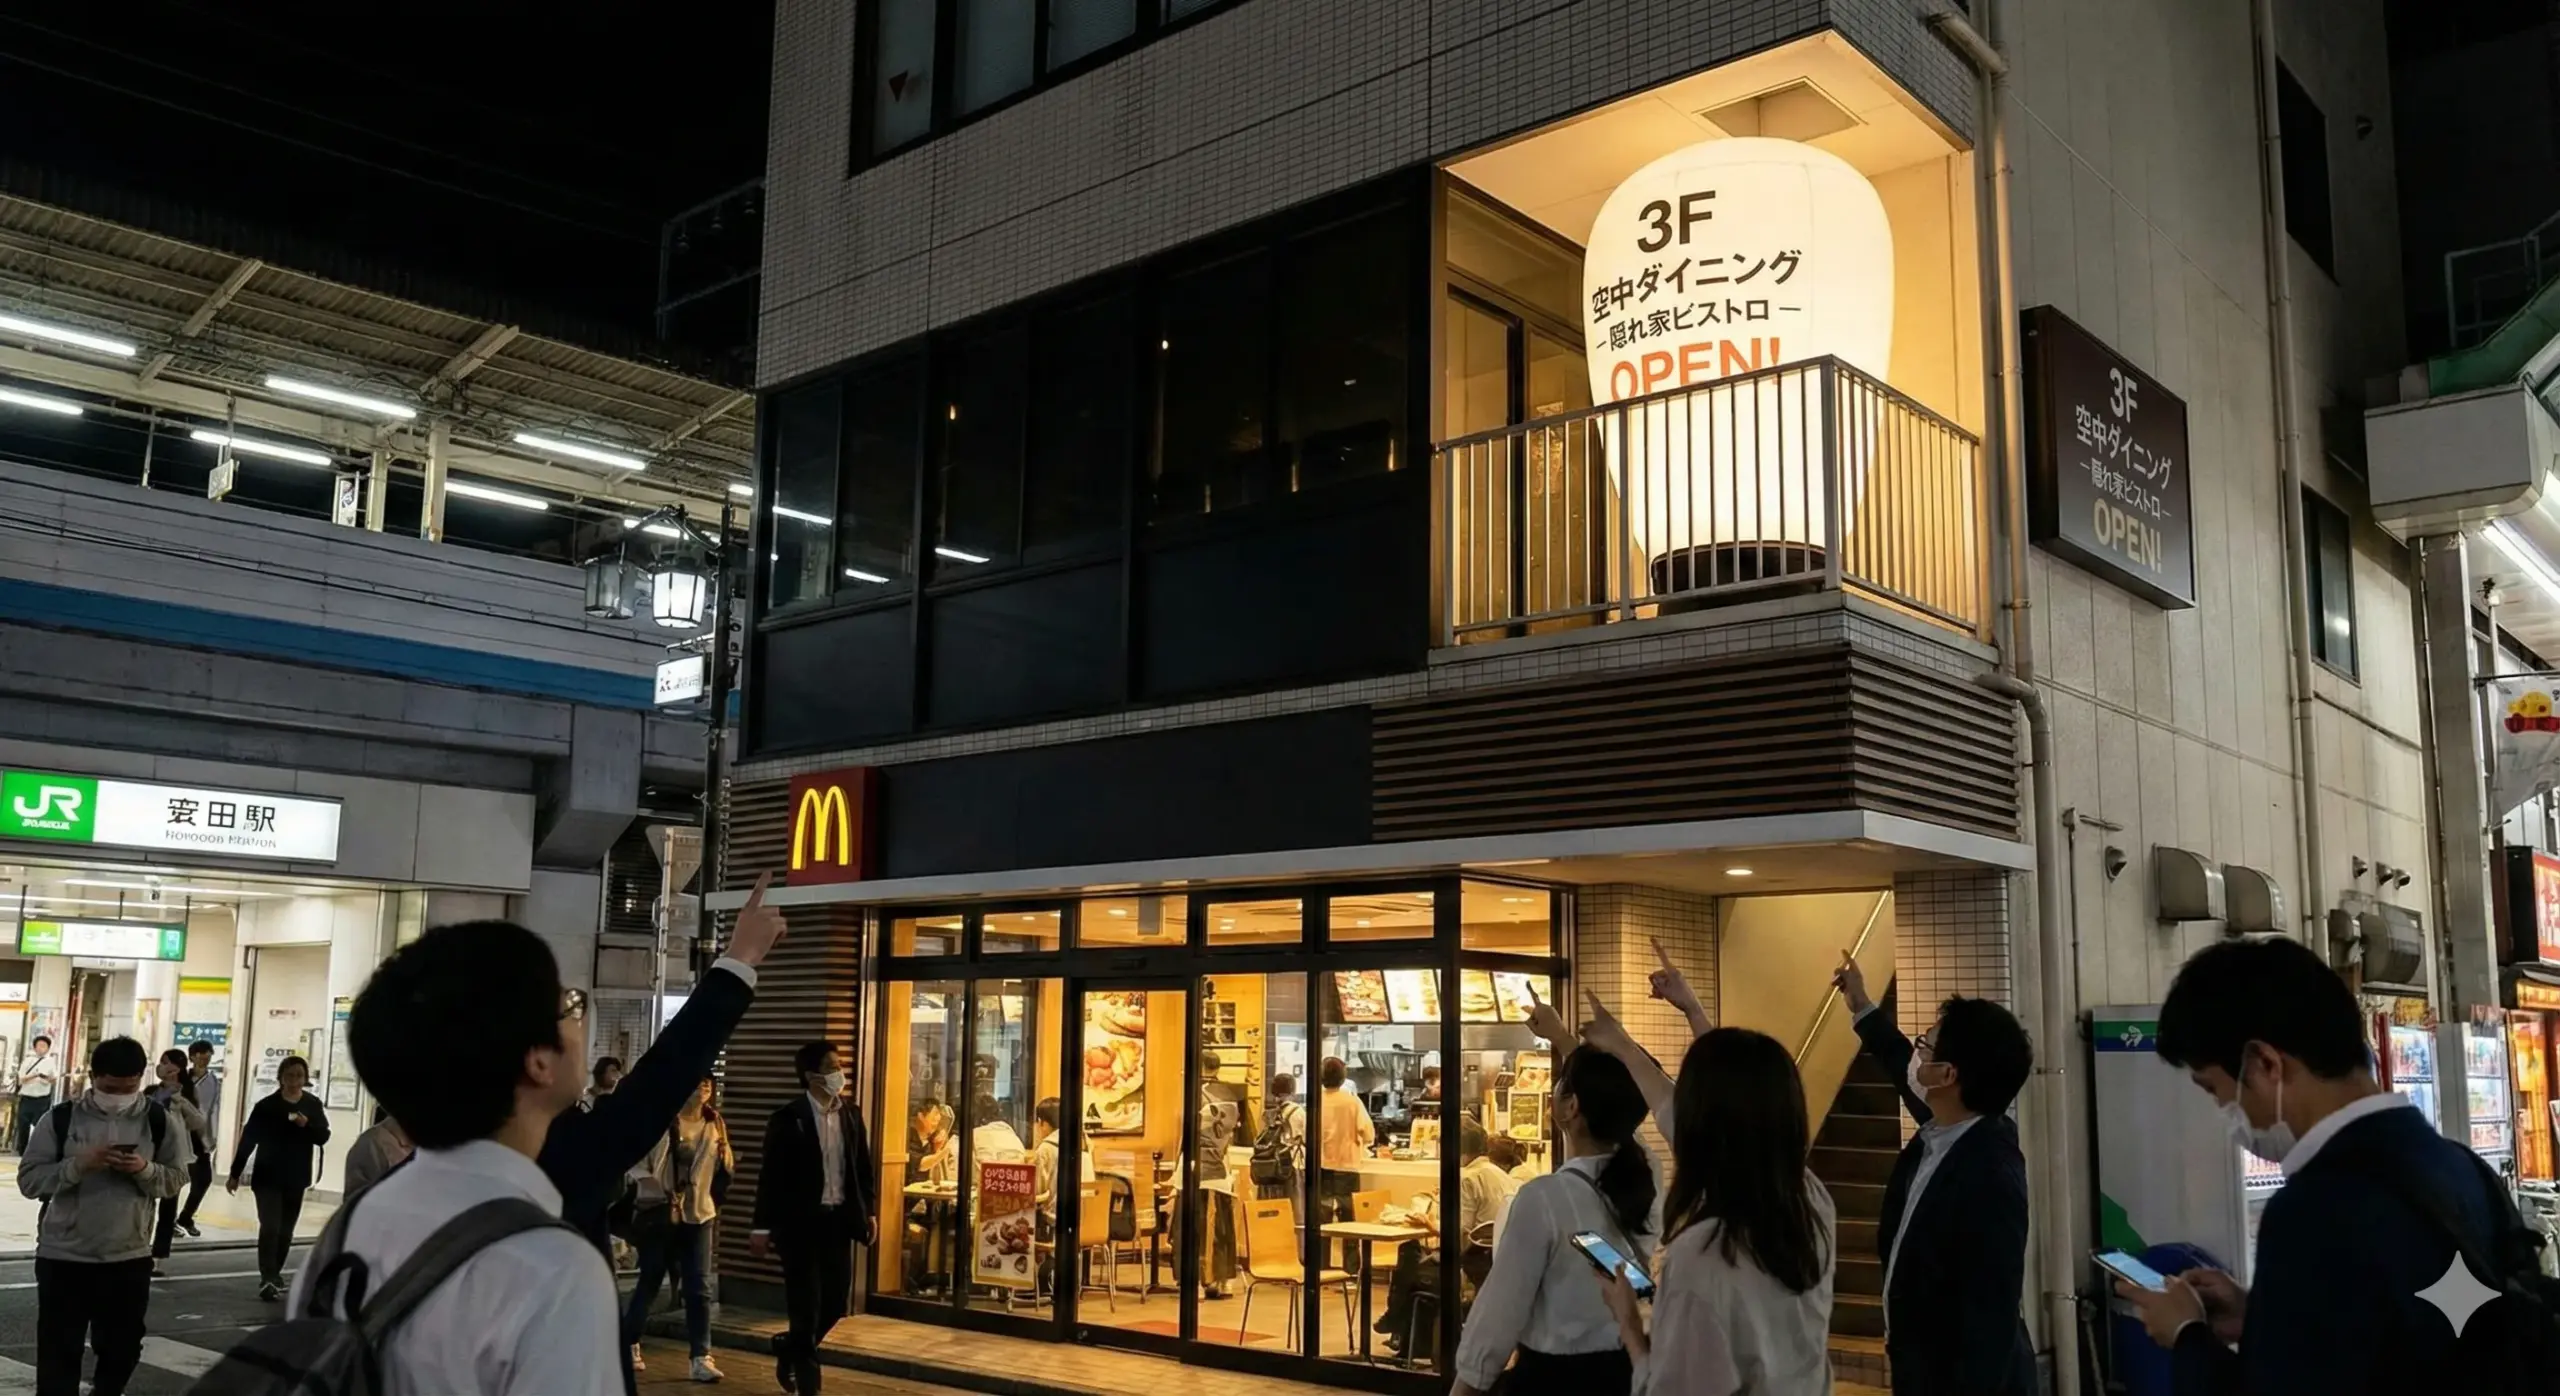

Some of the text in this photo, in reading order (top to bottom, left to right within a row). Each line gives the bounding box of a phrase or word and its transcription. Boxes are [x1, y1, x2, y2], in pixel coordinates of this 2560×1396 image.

[1637, 190, 1716, 253] 3F
[1592, 249, 1802, 324] 空中ダイニング
[2109, 367, 2138, 423] 3F
[2075, 404, 2172, 490] 空中ダイニング
[2093, 498, 2162, 574] OPEN!
[13, 784, 83, 822] JR
